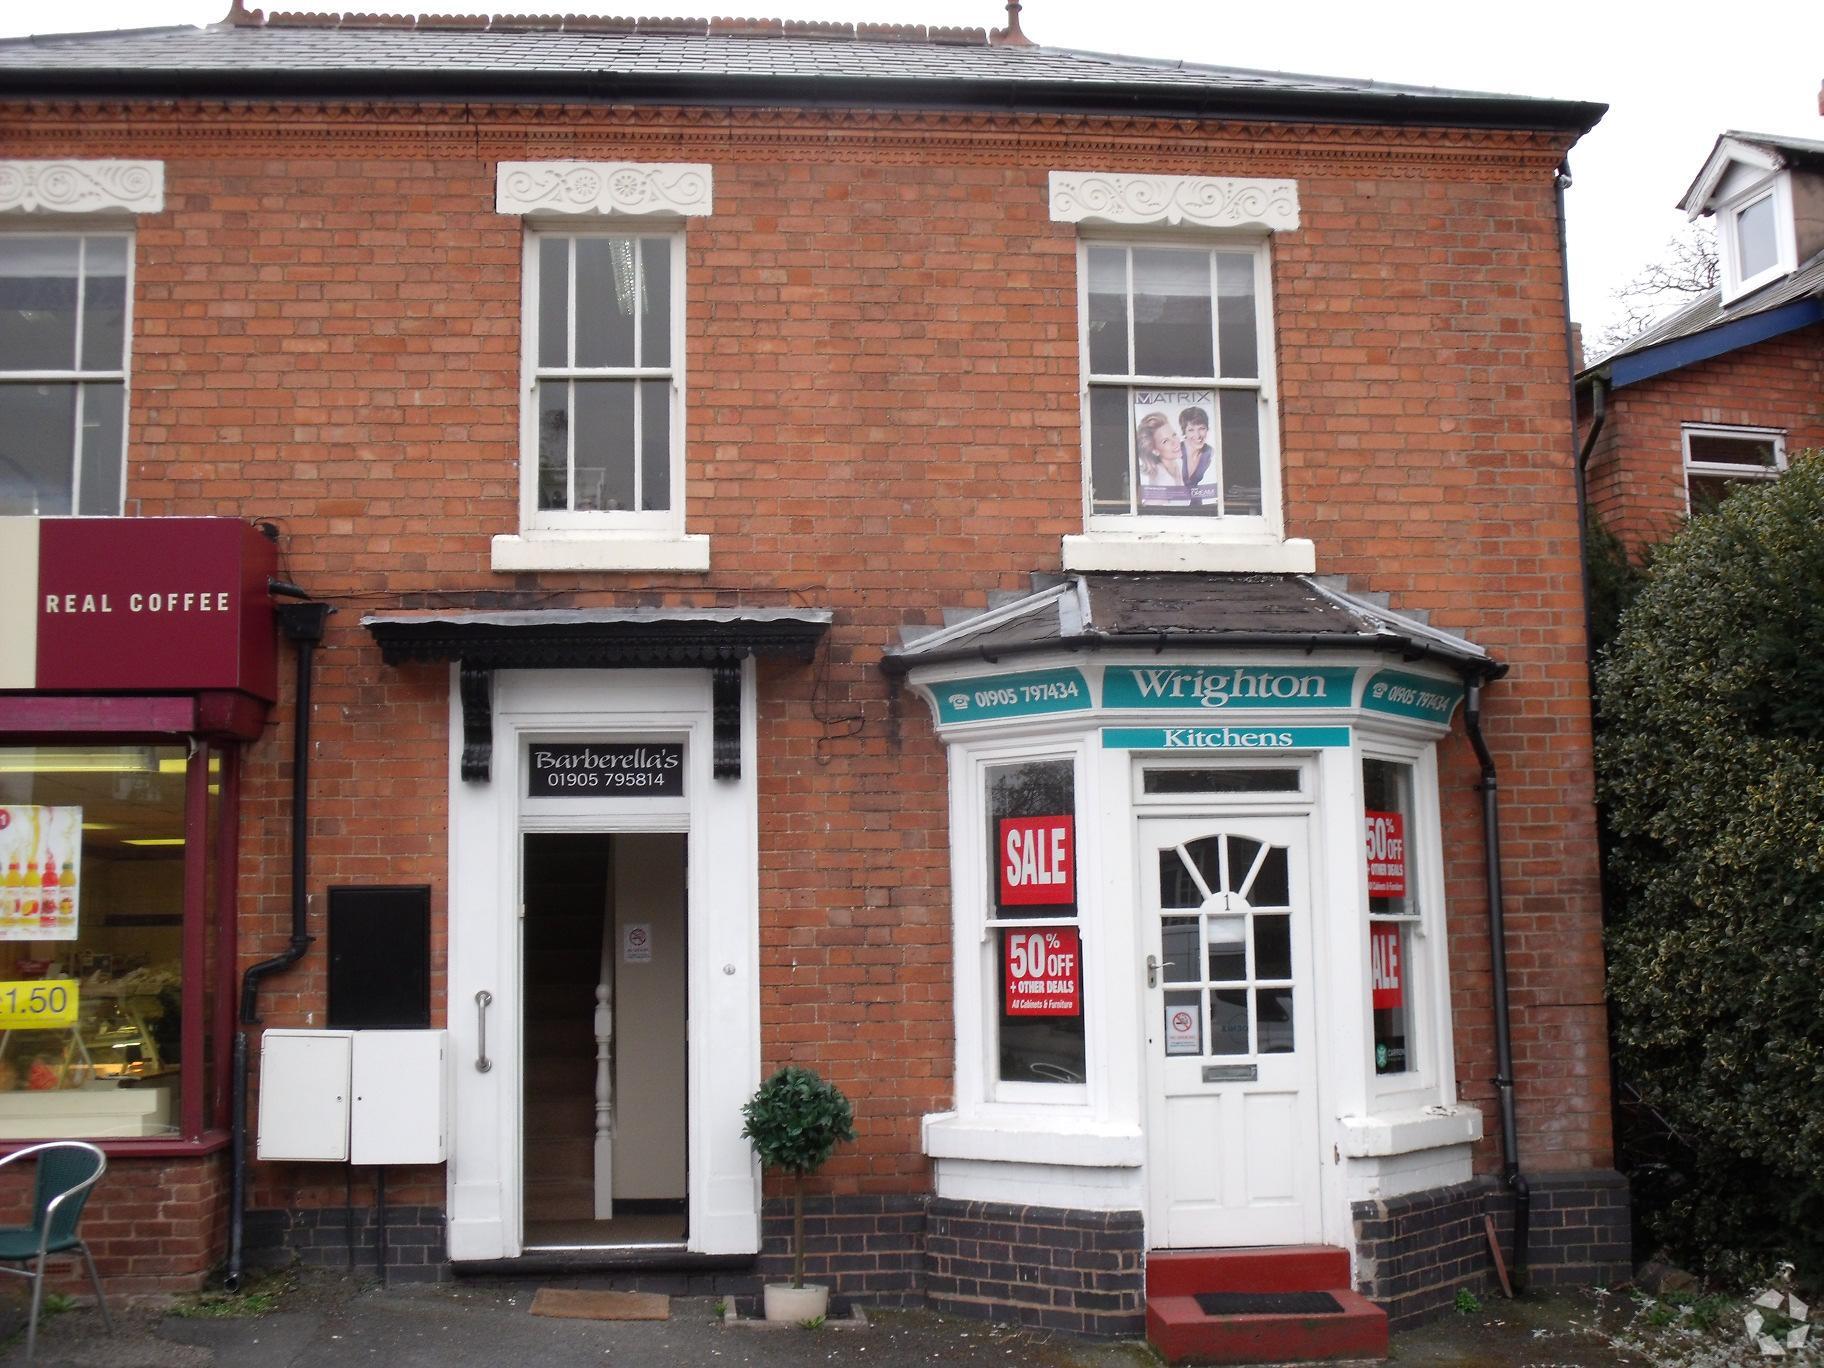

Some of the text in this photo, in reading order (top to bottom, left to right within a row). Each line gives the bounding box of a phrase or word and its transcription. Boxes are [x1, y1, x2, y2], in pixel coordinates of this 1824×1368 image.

[1136, 391, 1210, 404] MATRIX
[46, 592, 229, 613] REAL COFFEE
[974, 681, 1079, 708] 01905 797434
[1129, 668, 1327, 708] Wrighton
[1387, 686, 1451, 712] 01905 797434
[1162, 728, 1294, 748] Kitchens
[534, 748, 679, 769] Barberella's
[548, 773, 665, 786] 01905 795814
[1006, 827, 1067, 887] SALE
[1387, 838, 1402, 860] OFF
[1224, 894, 1231, 911] 1
[1010, 932, 1074, 979] 50% OFF
[1372, 934, 1399, 990] ALE
[1018, 980, 1045, 994] OTHER
[1046, 980, 1074, 994] DEALS
[0, 986, 67, 1014] 1.50
